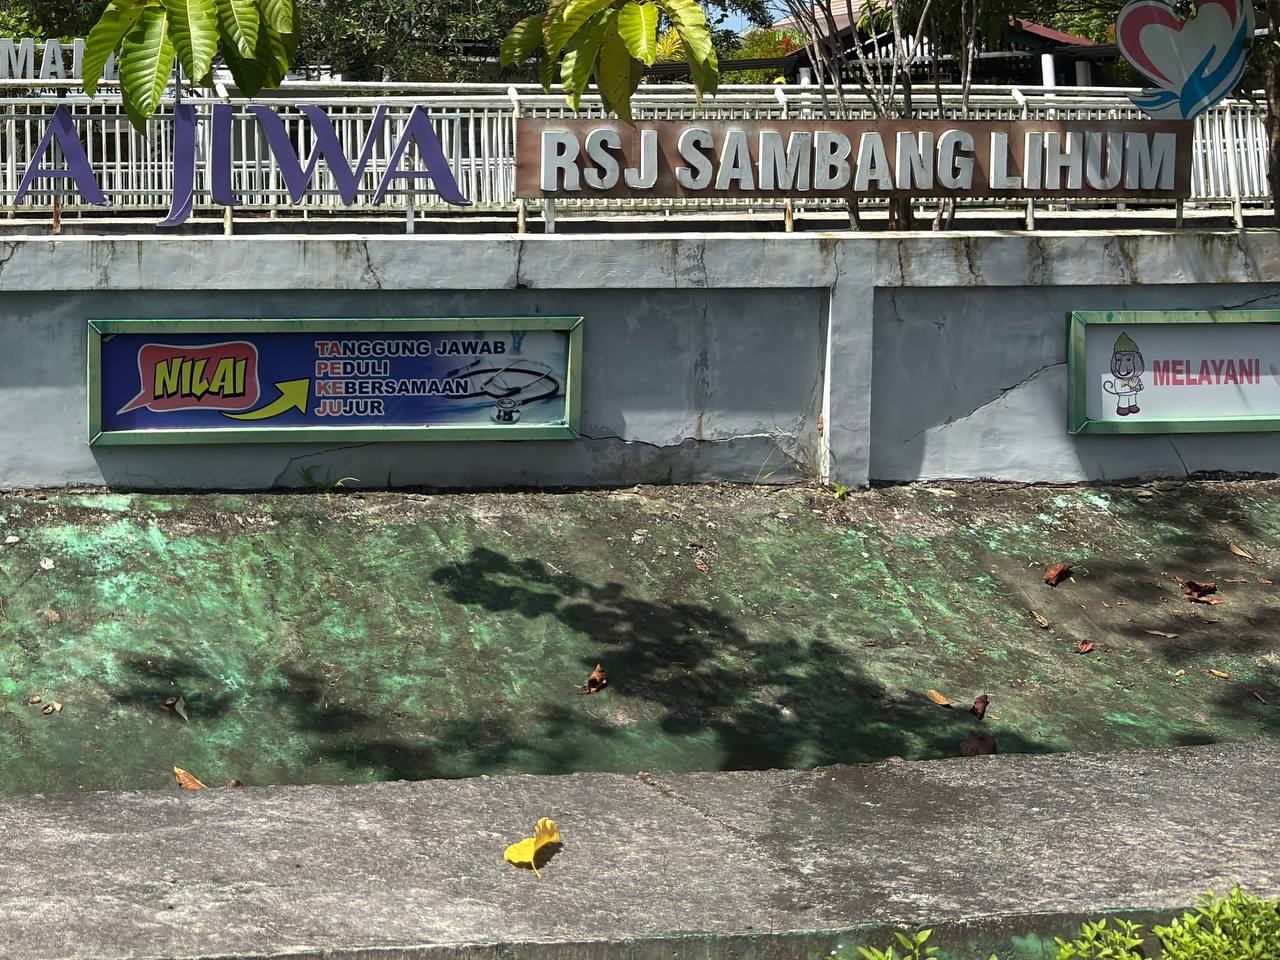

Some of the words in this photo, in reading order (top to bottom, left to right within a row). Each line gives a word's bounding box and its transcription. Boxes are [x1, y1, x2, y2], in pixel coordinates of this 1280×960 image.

[157, 104, 473, 227] JIWA
[540, 128, 658, 191] RSJ
[676, 128, 973, 191] SAMBANG
[990, 130, 1175, 191] LIHUM
[315, 340, 430, 357] TANGGUNG
[436, 340, 506, 356] JAWAB
[153, 355, 248, 401] NILAI
[315, 359, 390, 377] PEDULI
[1153, 358, 1260, 386] MELAYANI
[315, 379, 470, 396] KEBERSAMAAN
[314, 398, 385, 416] JUJUR
